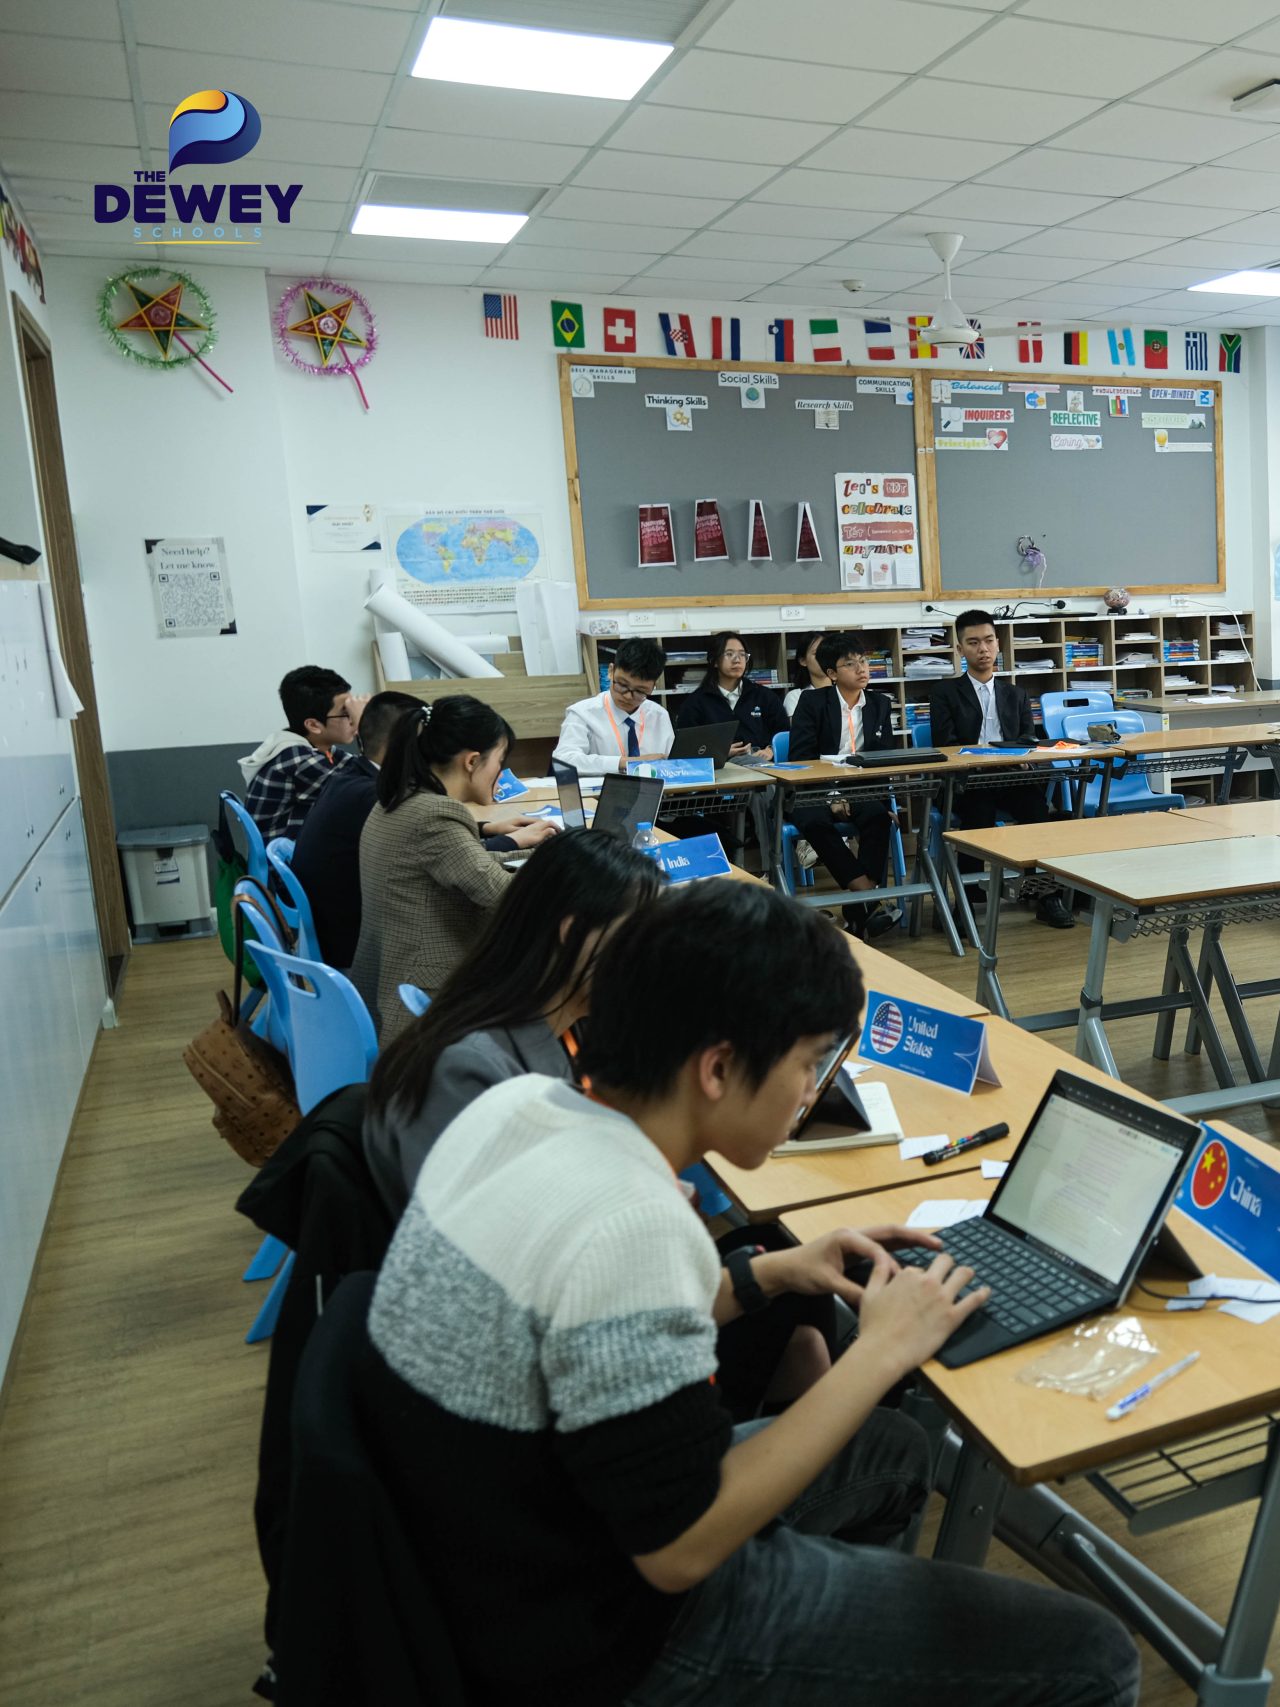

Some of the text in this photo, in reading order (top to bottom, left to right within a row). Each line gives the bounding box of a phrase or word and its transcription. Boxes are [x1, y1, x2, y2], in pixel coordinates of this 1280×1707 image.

[720, 373, 778, 386] Social Skills
[858, 379, 911, 387] COMMUNICATION
[950, 381, 1003, 391] Balanced
[1151, 388, 1195, 399] OPEN-MINDED
[646, 395, 708, 408] Thinking Skills
[797, 401, 854, 410] Research Skills
[964, 409, 1012, 421] INQUIRERS
[1052, 412, 1099, 426] REFLECTIVE
[1052, 435, 1084, 450] Caring
[841, 502, 913, 515] celebrate
[843, 544, 914, 558] anymore
[660, 769, 689, 778] Nigeria
[667, 856, 691, 869] India
[908, 1015, 939, 1040] United
[903, 1035, 933, 1059] States
[1229, 1175, 1263, 1218] China
